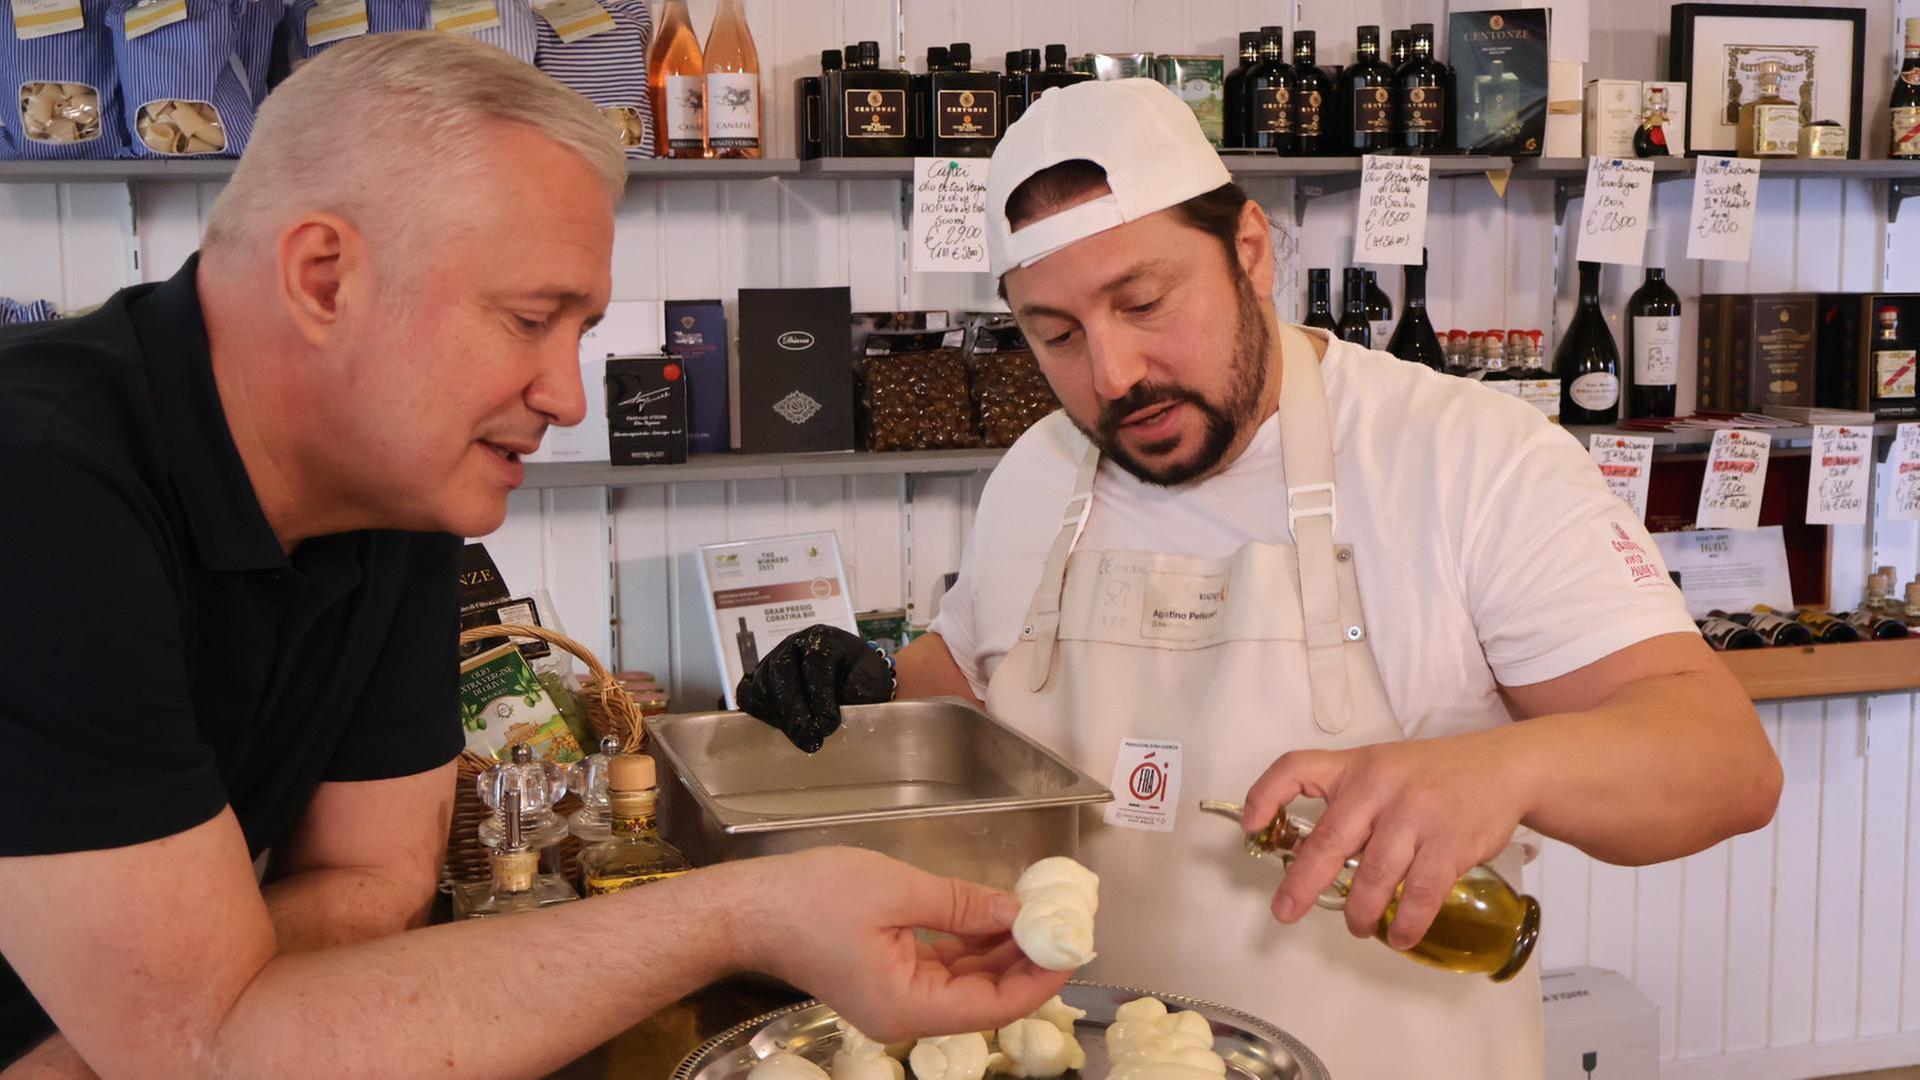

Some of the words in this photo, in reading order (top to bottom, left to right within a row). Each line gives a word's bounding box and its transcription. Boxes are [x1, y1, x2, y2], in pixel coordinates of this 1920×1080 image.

[1463, 29, 1531, 41] CENTONZE
[854, 105, 897, 113] CENTONZE
[679, 122, 704, 131] CANA
[756, 556, 790, 565] WINNERS
[764, 606, 785, 616] GRAN
[786, 604, 813, 614] PREGIO
[1152, 608, 1187, 620] Agatino
[765, 614, 801, 624] CORATINA
[803, 610, 816, 619] BIO
[471, 667, 491, 681] OLIO
[459, 681, 480, 697] XTRA
[478, 668, 515, 692] VERGINE
[472, 688, 484, 698] DI
[482, 679, 508, 694] OLIVA
[1136, 768, 1155, 794] FRA
